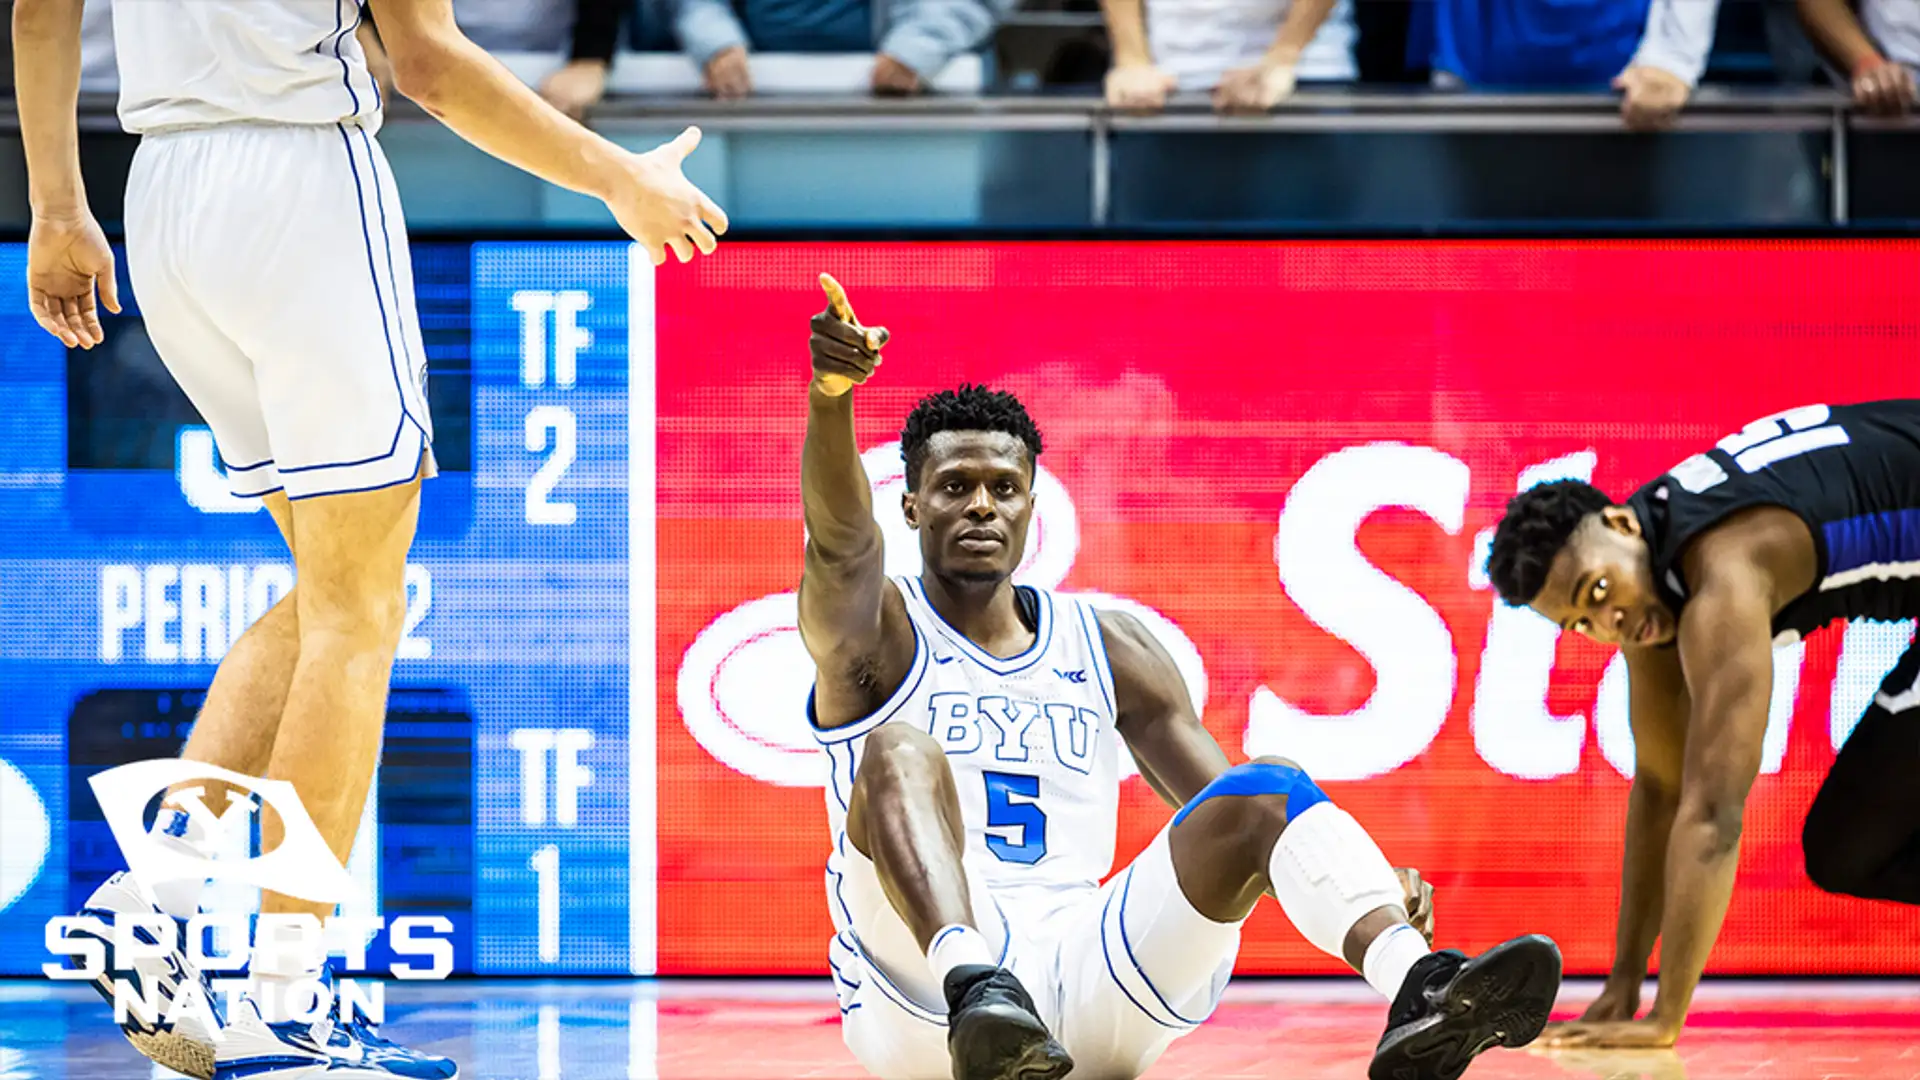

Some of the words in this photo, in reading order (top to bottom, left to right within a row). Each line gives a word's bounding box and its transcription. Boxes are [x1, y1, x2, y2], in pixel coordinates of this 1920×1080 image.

[508, 290, 593, 390] TF
[525, 406, 577, 525] 2
[397, 563, 432, 660] 2
[508, 728, 594, 829] TF
[928, 691, 1101, 775] BYU
[981, 770, 1048, 866] 5
[528, 843, 560, 963] 1
